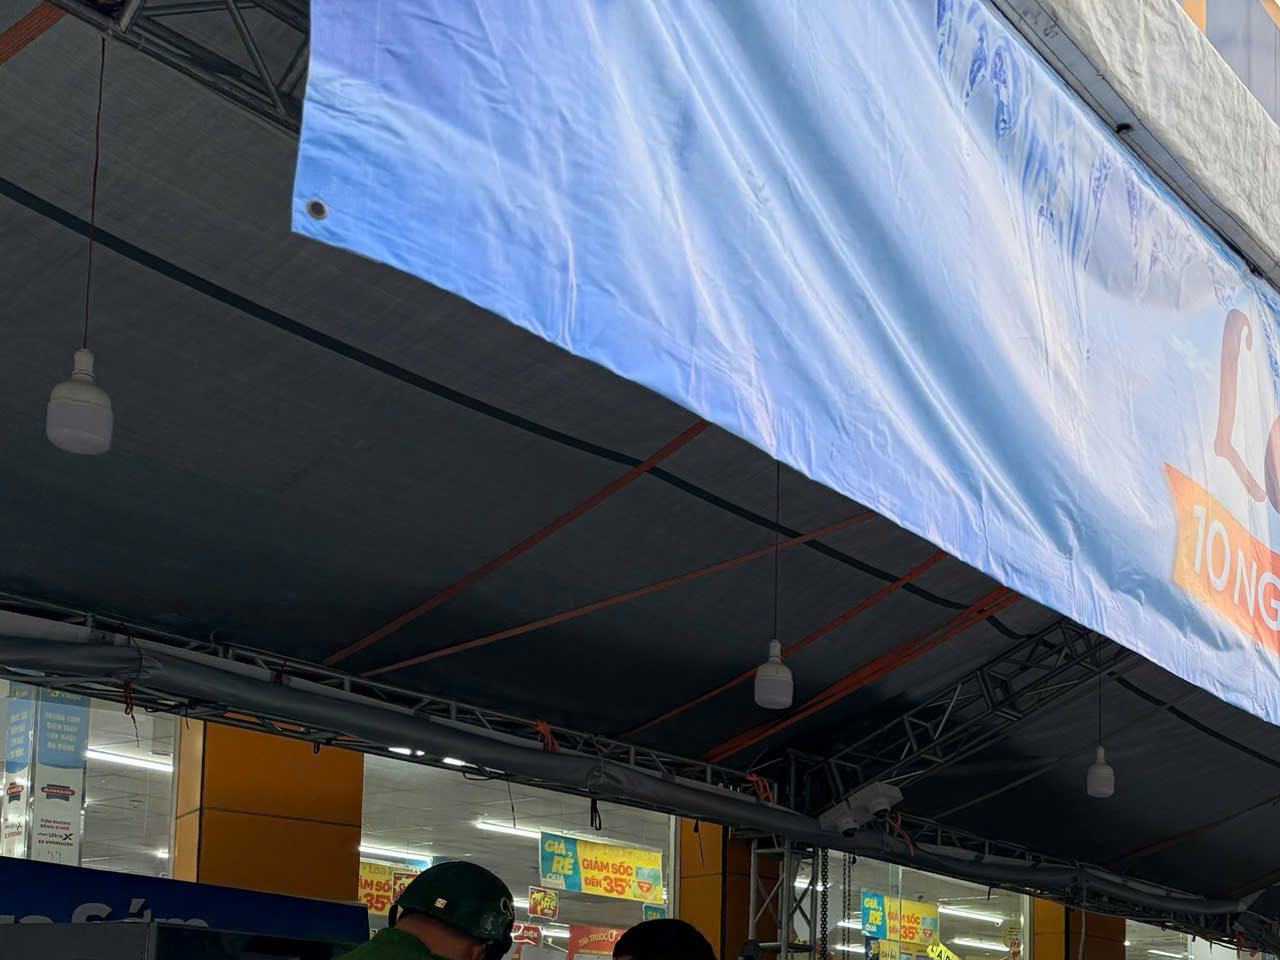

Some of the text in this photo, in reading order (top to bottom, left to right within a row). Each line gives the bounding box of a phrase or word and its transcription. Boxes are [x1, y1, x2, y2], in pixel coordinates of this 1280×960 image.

[1193, 504, 1231, 592] 10
[581, 856, 633, 877] GIẢM SỐC
[375, 879, 393, 893] SỐ
